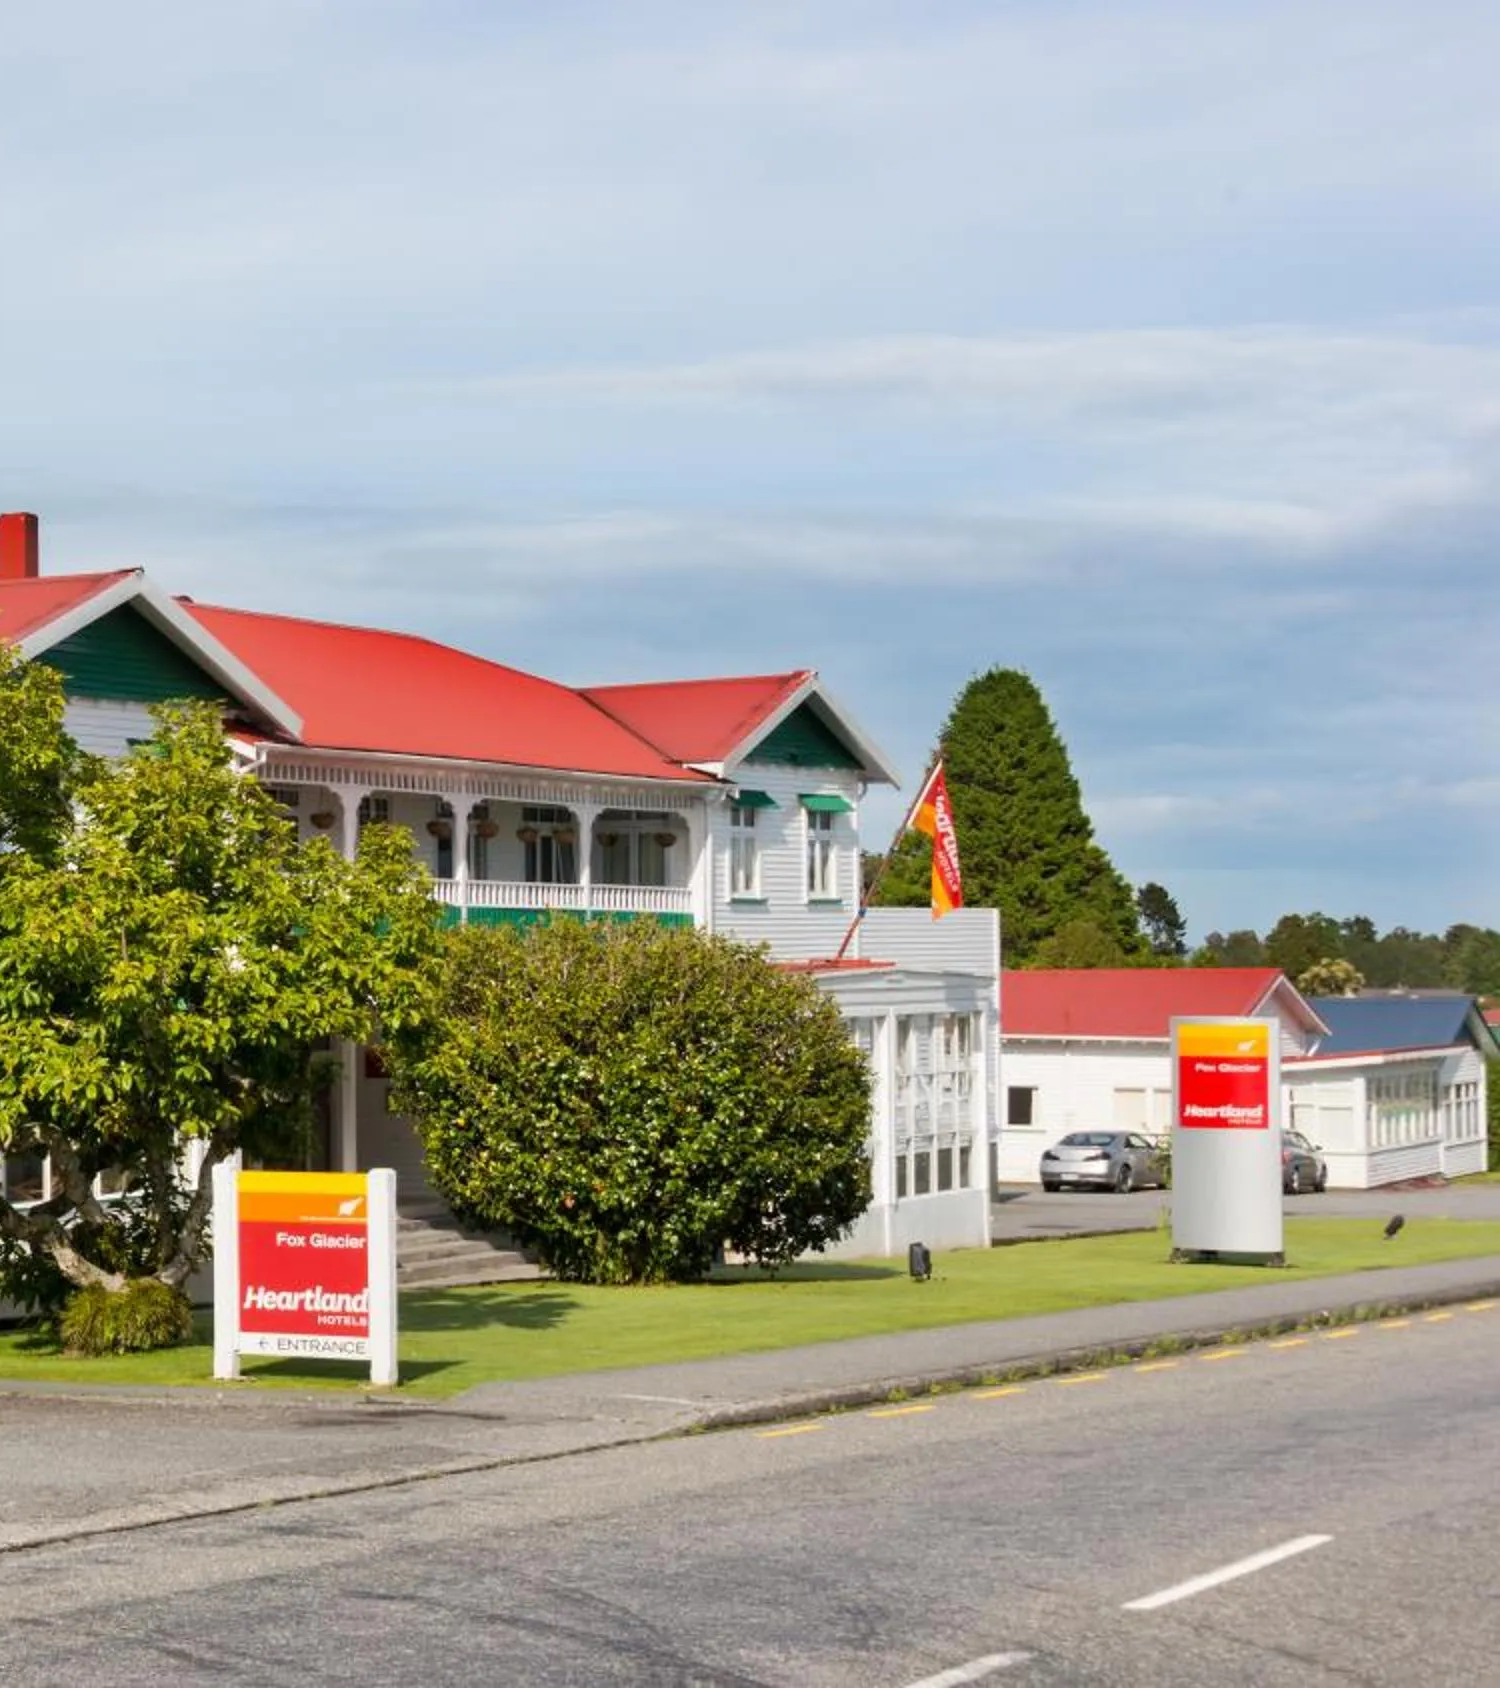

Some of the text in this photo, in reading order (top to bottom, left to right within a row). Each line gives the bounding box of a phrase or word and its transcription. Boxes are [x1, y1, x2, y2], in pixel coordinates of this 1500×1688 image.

[1183, 1104, 1263, 1118] Heartland
[276, 1232, 367, 1249] Fox Glacier
[244, 1285, 369, 1313] Heartland
[317, 1315, 368, 1327] HOTELS
[277, 1339, 366, 1354] ENTRANCE
